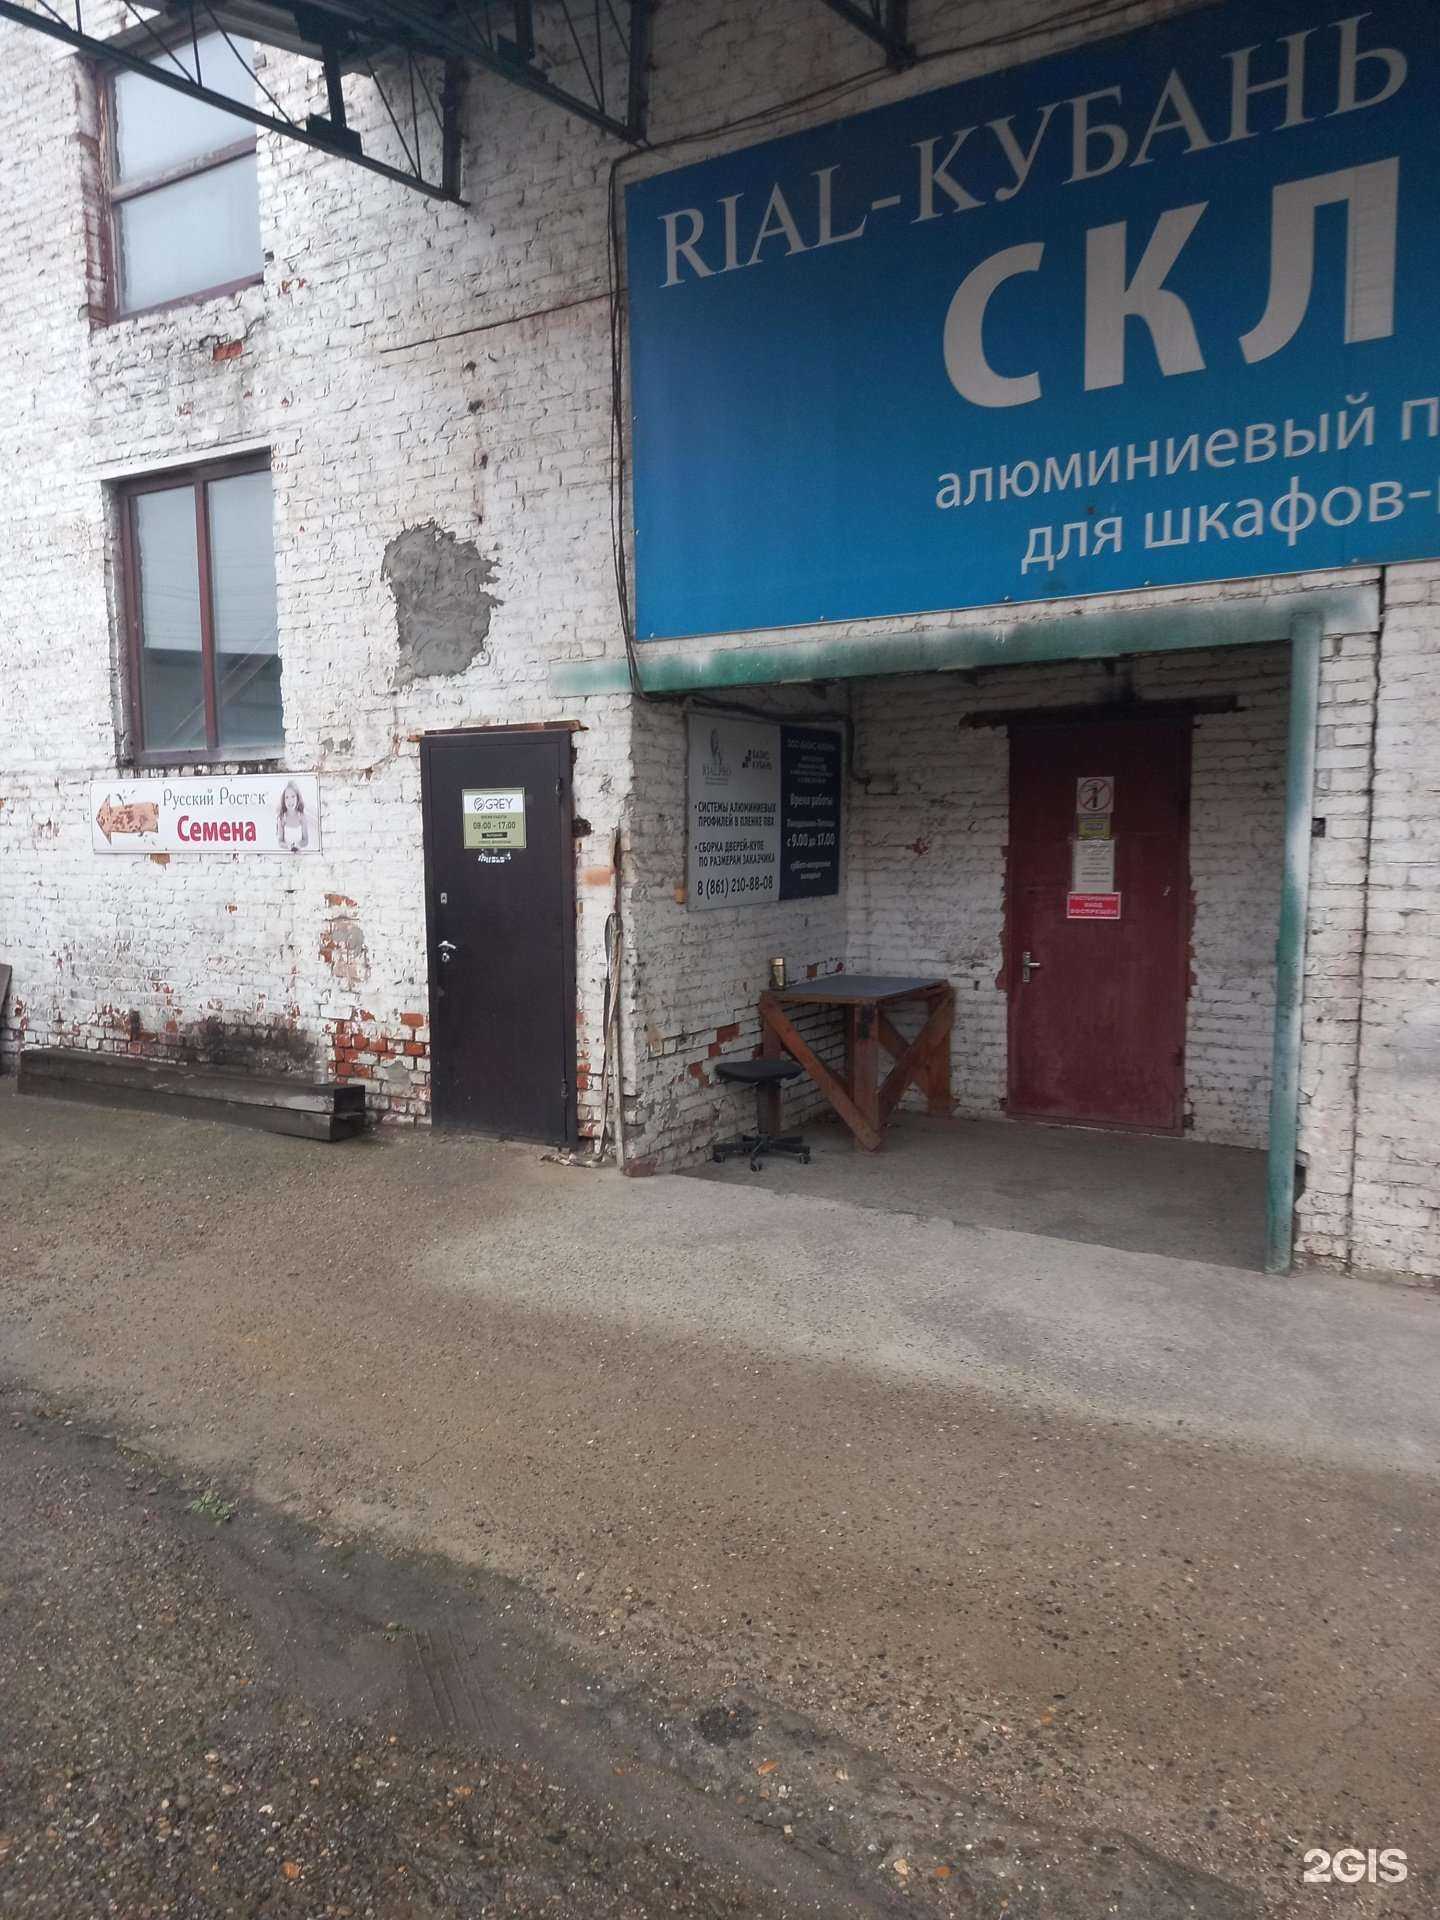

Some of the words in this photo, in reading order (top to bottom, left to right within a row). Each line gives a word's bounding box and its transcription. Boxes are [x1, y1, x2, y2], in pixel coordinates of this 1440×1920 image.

[934, 391, 1375, 510] алюминиевый
[1020, 516, 1123, 575] для
[1143, 476, 1440, 550] шкафов-
[163, 788, 214, 809] Русский
[485, 798, 513, 810] GREY
[698, 801, 729, 813] СИСТЕМЫ
[177, 815, 257, 842] Семена
[697, 880, 704, 896] 8
[706, 877, 729, 900] (861)
[731, 875, 773, 892] 210-88-08
